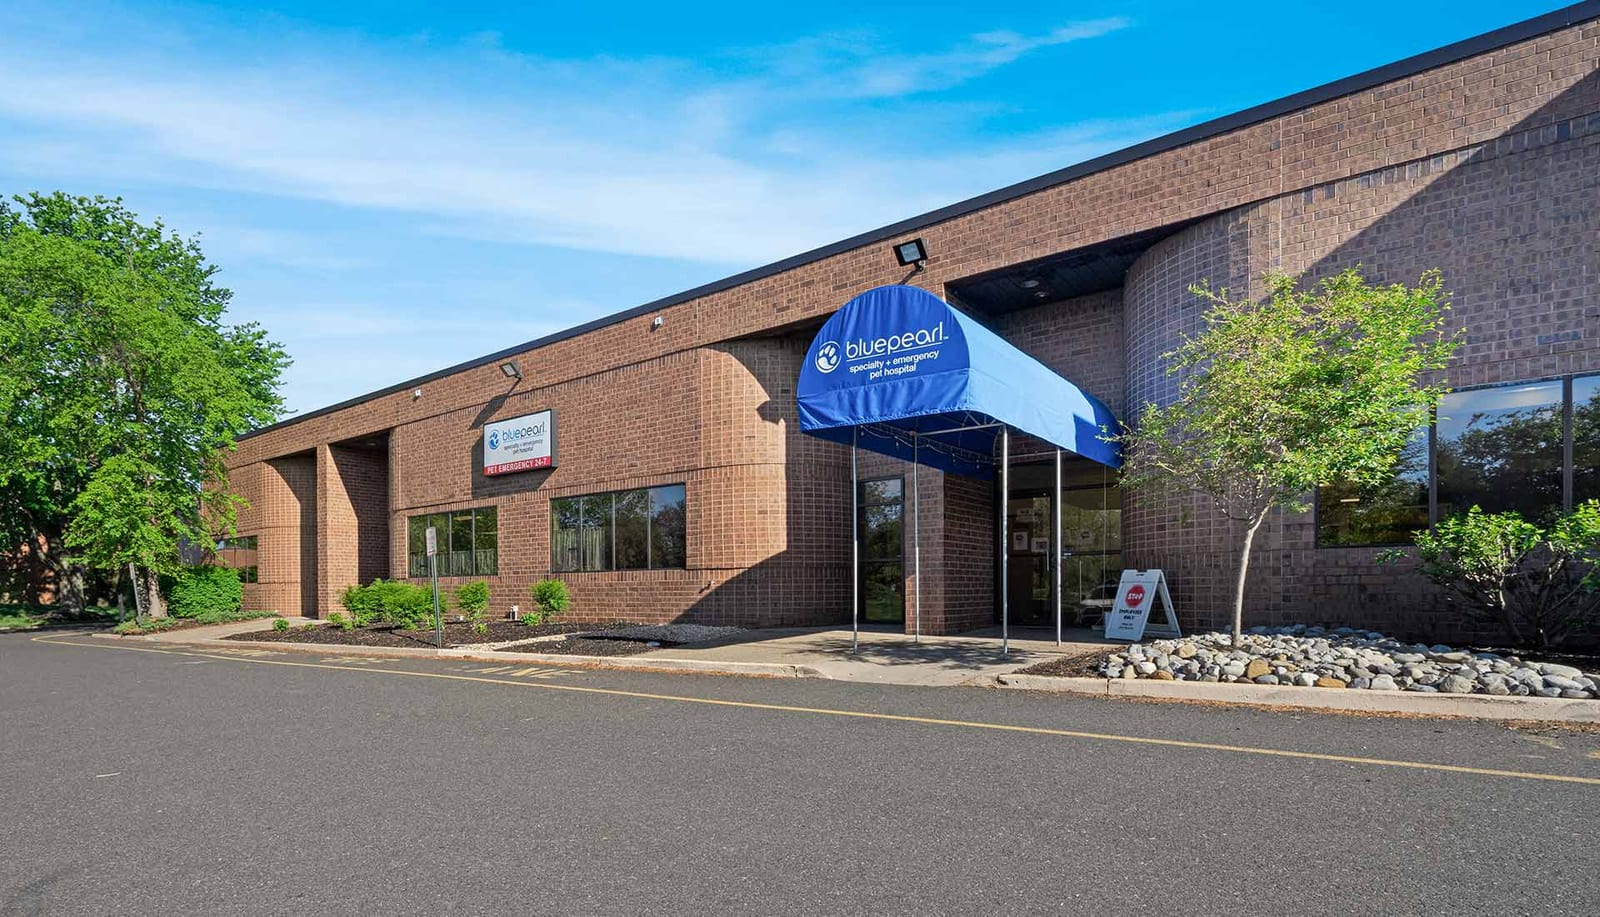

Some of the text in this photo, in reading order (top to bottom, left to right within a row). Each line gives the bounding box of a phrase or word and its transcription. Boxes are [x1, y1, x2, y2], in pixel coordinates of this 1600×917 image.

[846, 322, 943, 358] bluepearl
[849, 358, 884, 374] specialty
[892, 350, 939, 365] emergency
[869, 363, 917, 380] pet hospital
[502, 421, 545, 441] bluepearl
[487, 457, 547, 474] PET EMERGENCY 24-7
[1127, 592, 1143, 600] STOP
